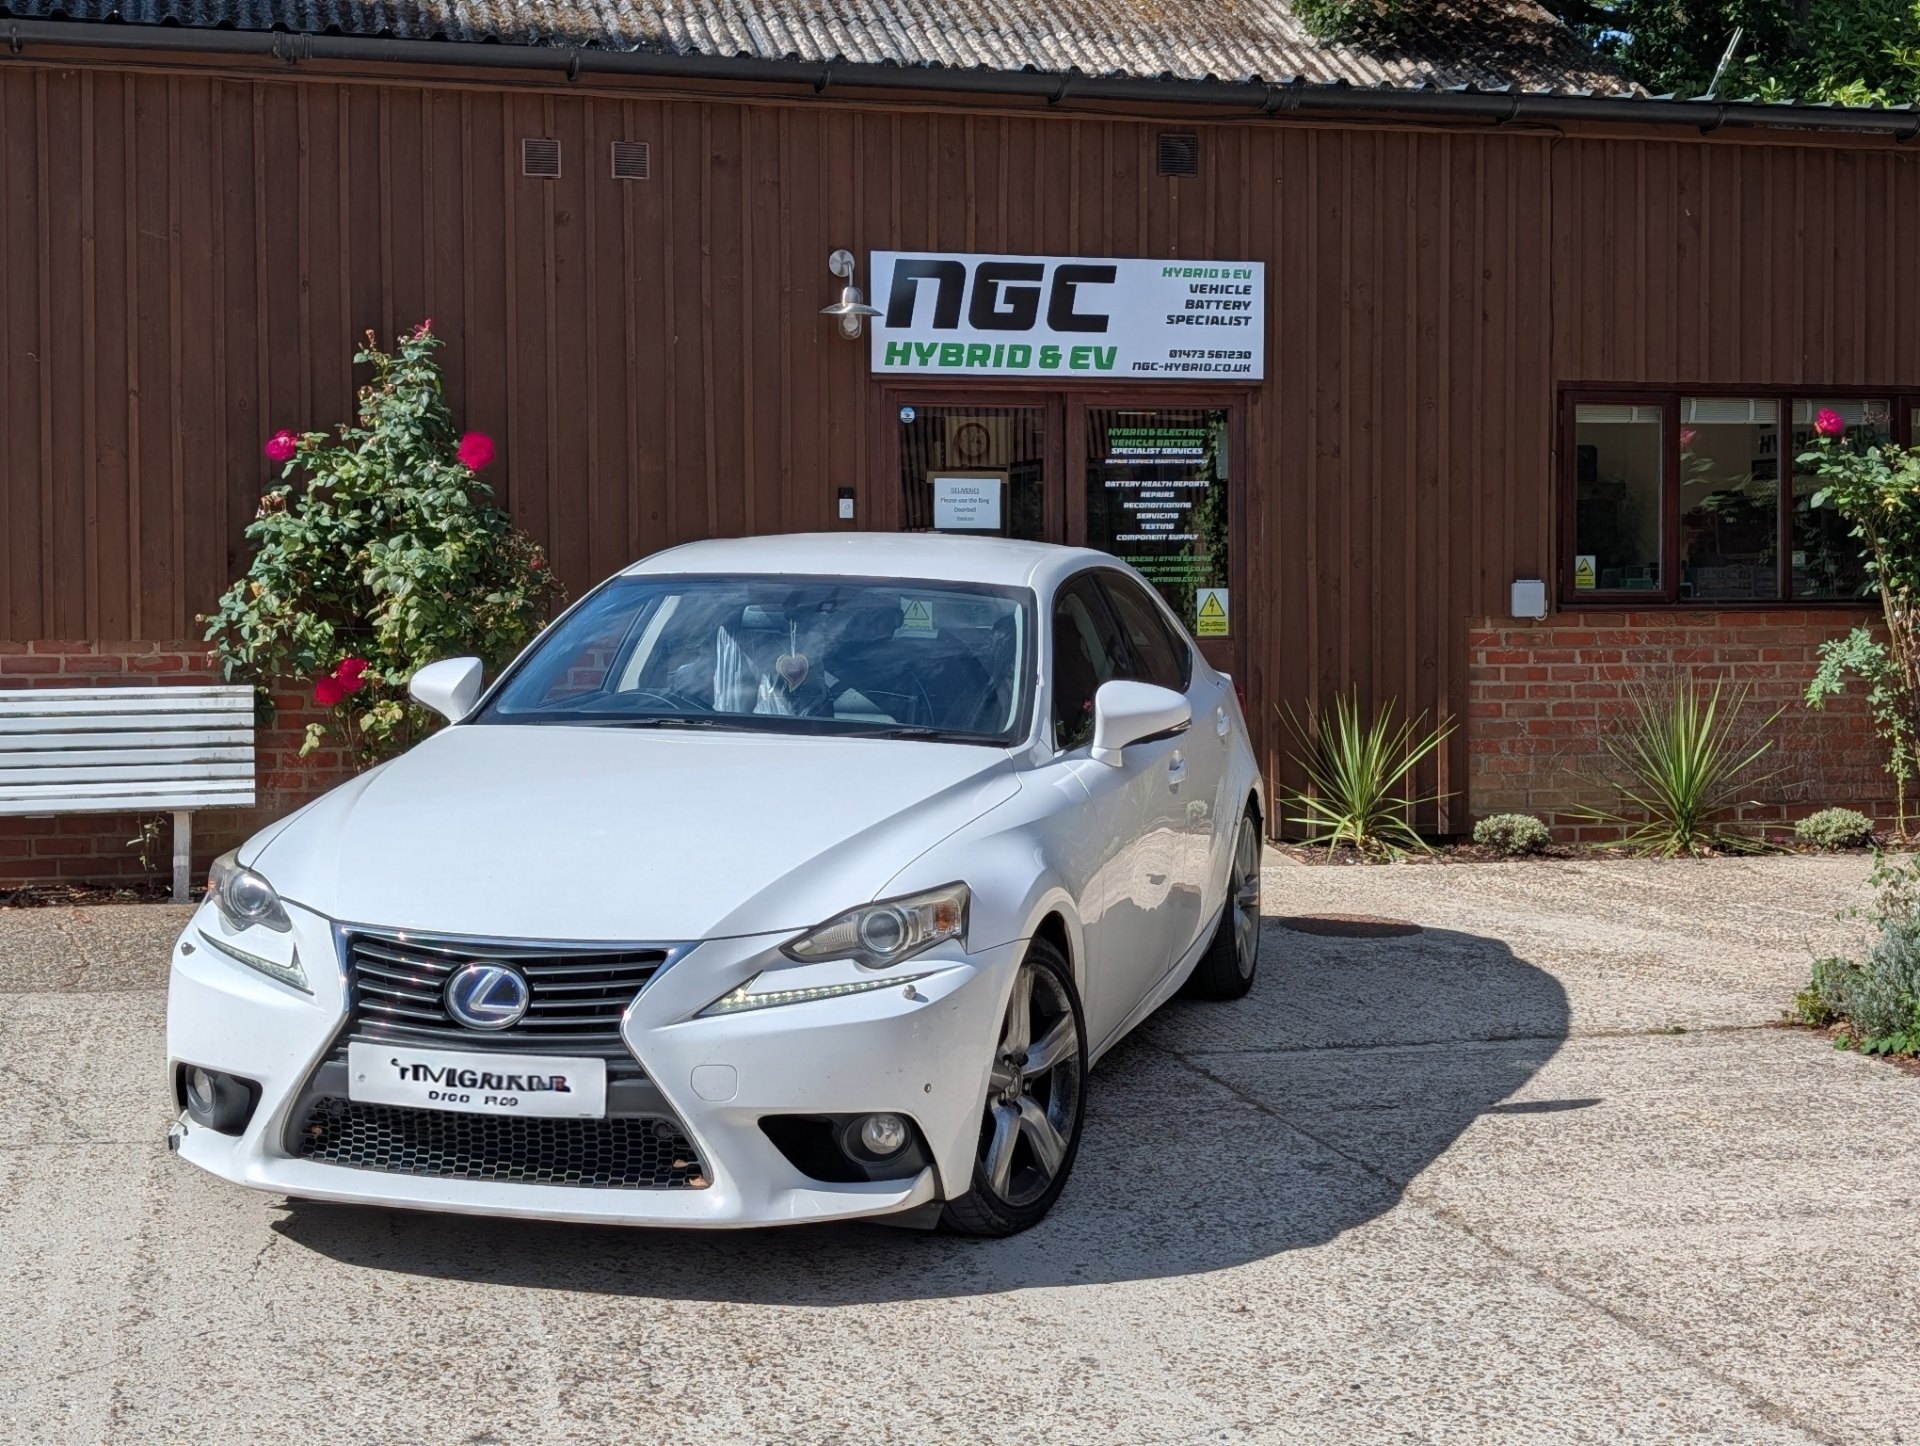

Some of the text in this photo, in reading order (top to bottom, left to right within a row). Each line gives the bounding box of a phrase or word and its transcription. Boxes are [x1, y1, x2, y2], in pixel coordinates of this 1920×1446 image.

[1161, 266, 1253, 280] HYBRID & EV
[885, 258, 1117, 333] NGC
[1188, 283, 1252, 296] VEHICLE
[1184, 298, 1252, 311] BATTERY
[1165, 314, 1252, 327] SPECIALIST
[884, 340, 1118, 370] HYBRID & EV
[1168, 348, 1252, 360] 01473 561230
[1132, 361, 1252, 373] NGC-HYBRID.CO.UK
[1108, 428, 1148, 436] HYBRID
[1157, 428, 1206, 437] ELECTRIC
[1111, 439, 1203, 447] VEHICLE BATTERY
[1111, 447, 1203, 455] SPECIALIST SERVICES
[1105, 480, 1141, 488] BATTERY
[1141, 480, 1172, 488] HEALTH
